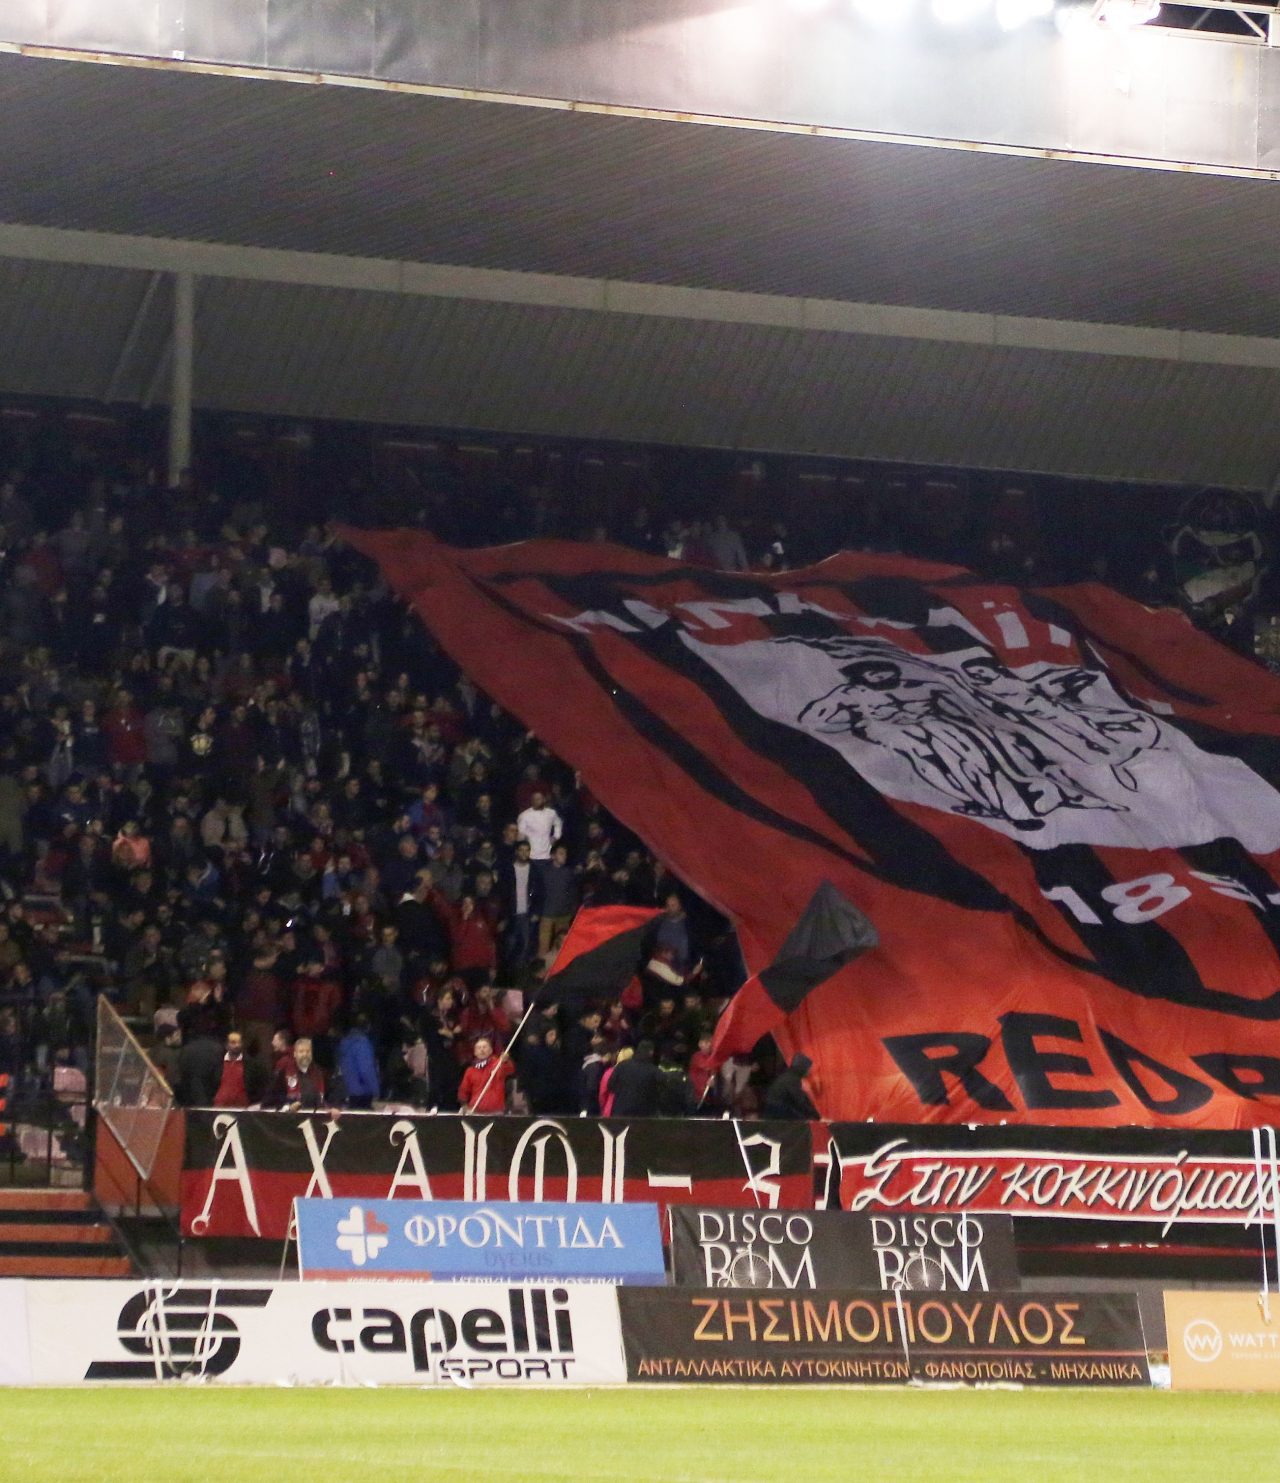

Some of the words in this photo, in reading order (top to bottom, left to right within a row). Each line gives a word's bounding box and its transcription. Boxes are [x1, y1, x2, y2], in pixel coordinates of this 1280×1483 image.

[852, 1138, 996, 1211] Στην
[403, 1208, 624, 1249] ΦΡΟΝΤΙΔΑ
[698, 1212, 813, 1244] DISCO
[870, 1217, 984, 1248] DISCO
[312, 1288, 574, 1372] capelli
[691, 1299, 1086, 1345] ΖΗΣΙΜΟΠΟΥΛΟΣ
[440, 1359, 575, 1379] SPORT
[638, 1358, 776, 1377] ΑΝΤΑΛΛΑΚΤΙΚΑ
[781, 1359, 909, 1378] ΑΥΤΟΚΙΝΗΤΩΝ
[1050, 1363, 1142, 1380] ΜΗΧΑΝΙΚΑ
